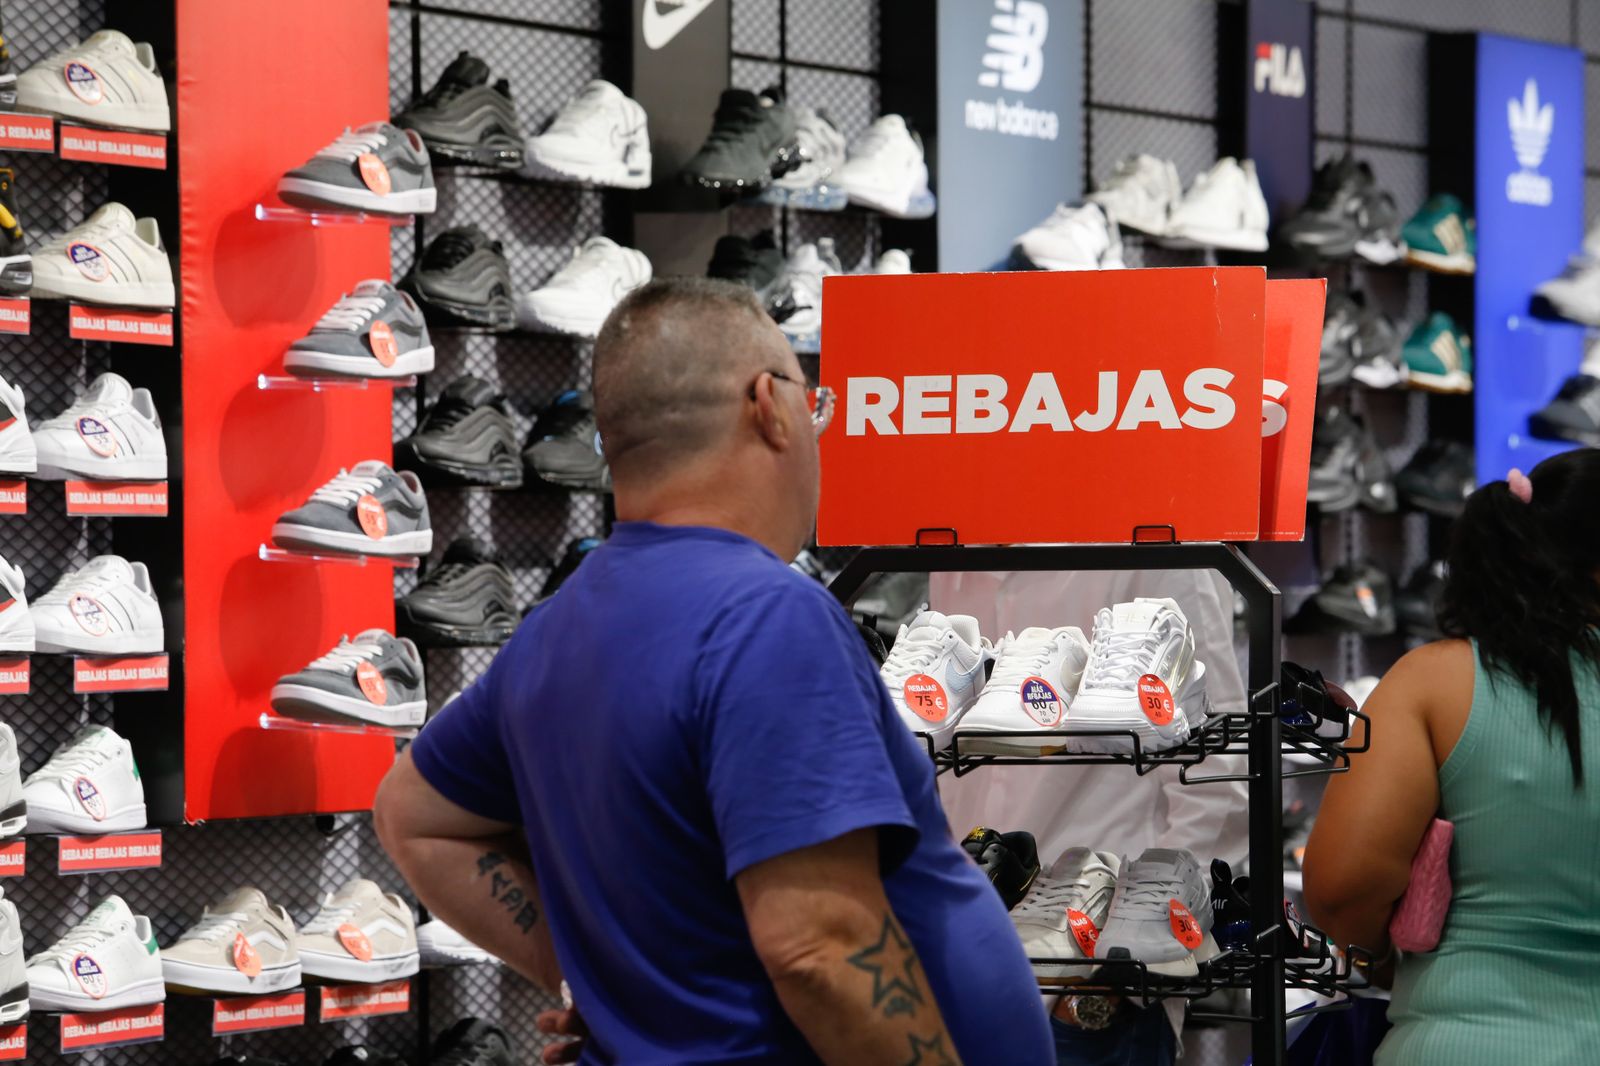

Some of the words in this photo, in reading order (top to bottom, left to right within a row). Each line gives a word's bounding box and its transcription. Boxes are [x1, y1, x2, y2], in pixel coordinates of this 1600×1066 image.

[1254, 42, 1306, 98] FILA
[965, 99, 996, 130] new
[997, 97, 1059, 140] balance
[846, 368, 1236, 436] REBAJAS
[907, 684, 937, 692] REBAJAS
